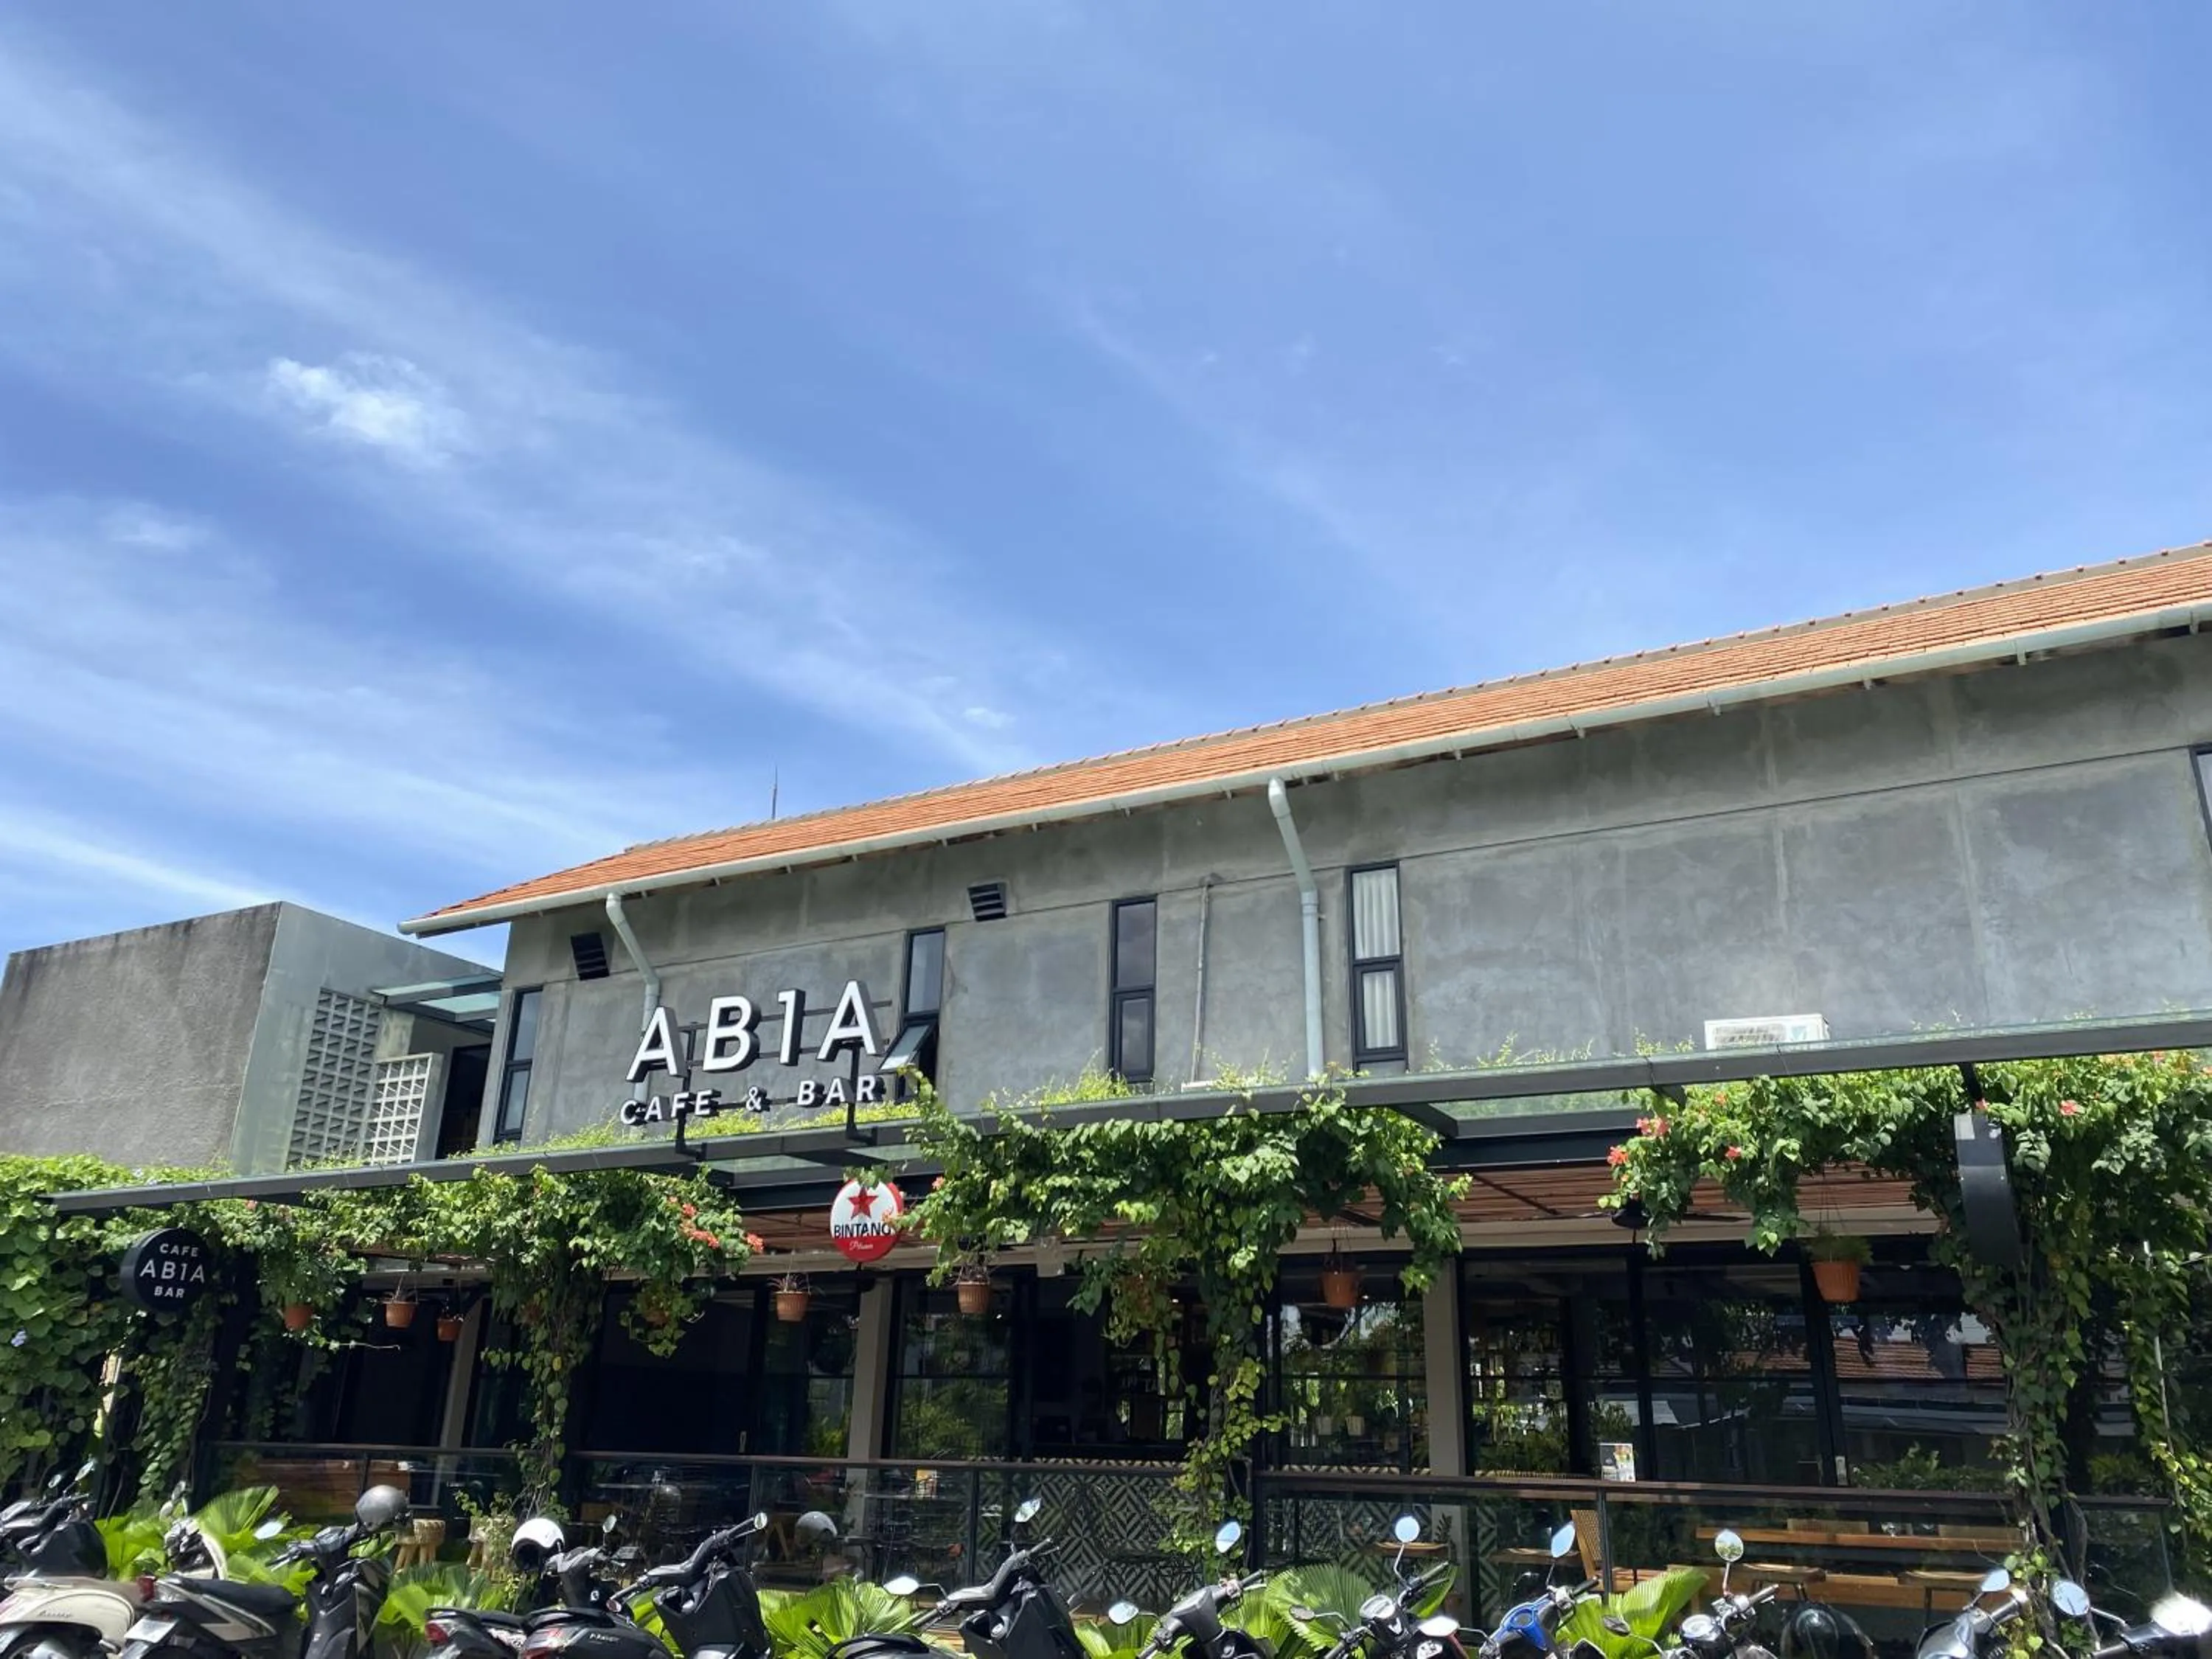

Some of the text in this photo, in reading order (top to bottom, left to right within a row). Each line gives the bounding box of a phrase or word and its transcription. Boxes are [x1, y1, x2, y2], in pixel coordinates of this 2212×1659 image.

[620, 1074, 882, 1125] CAFE & BAR
[159, 1243, 199, 1257] CAFE
[153, 1285, 185, 1298] BAR
